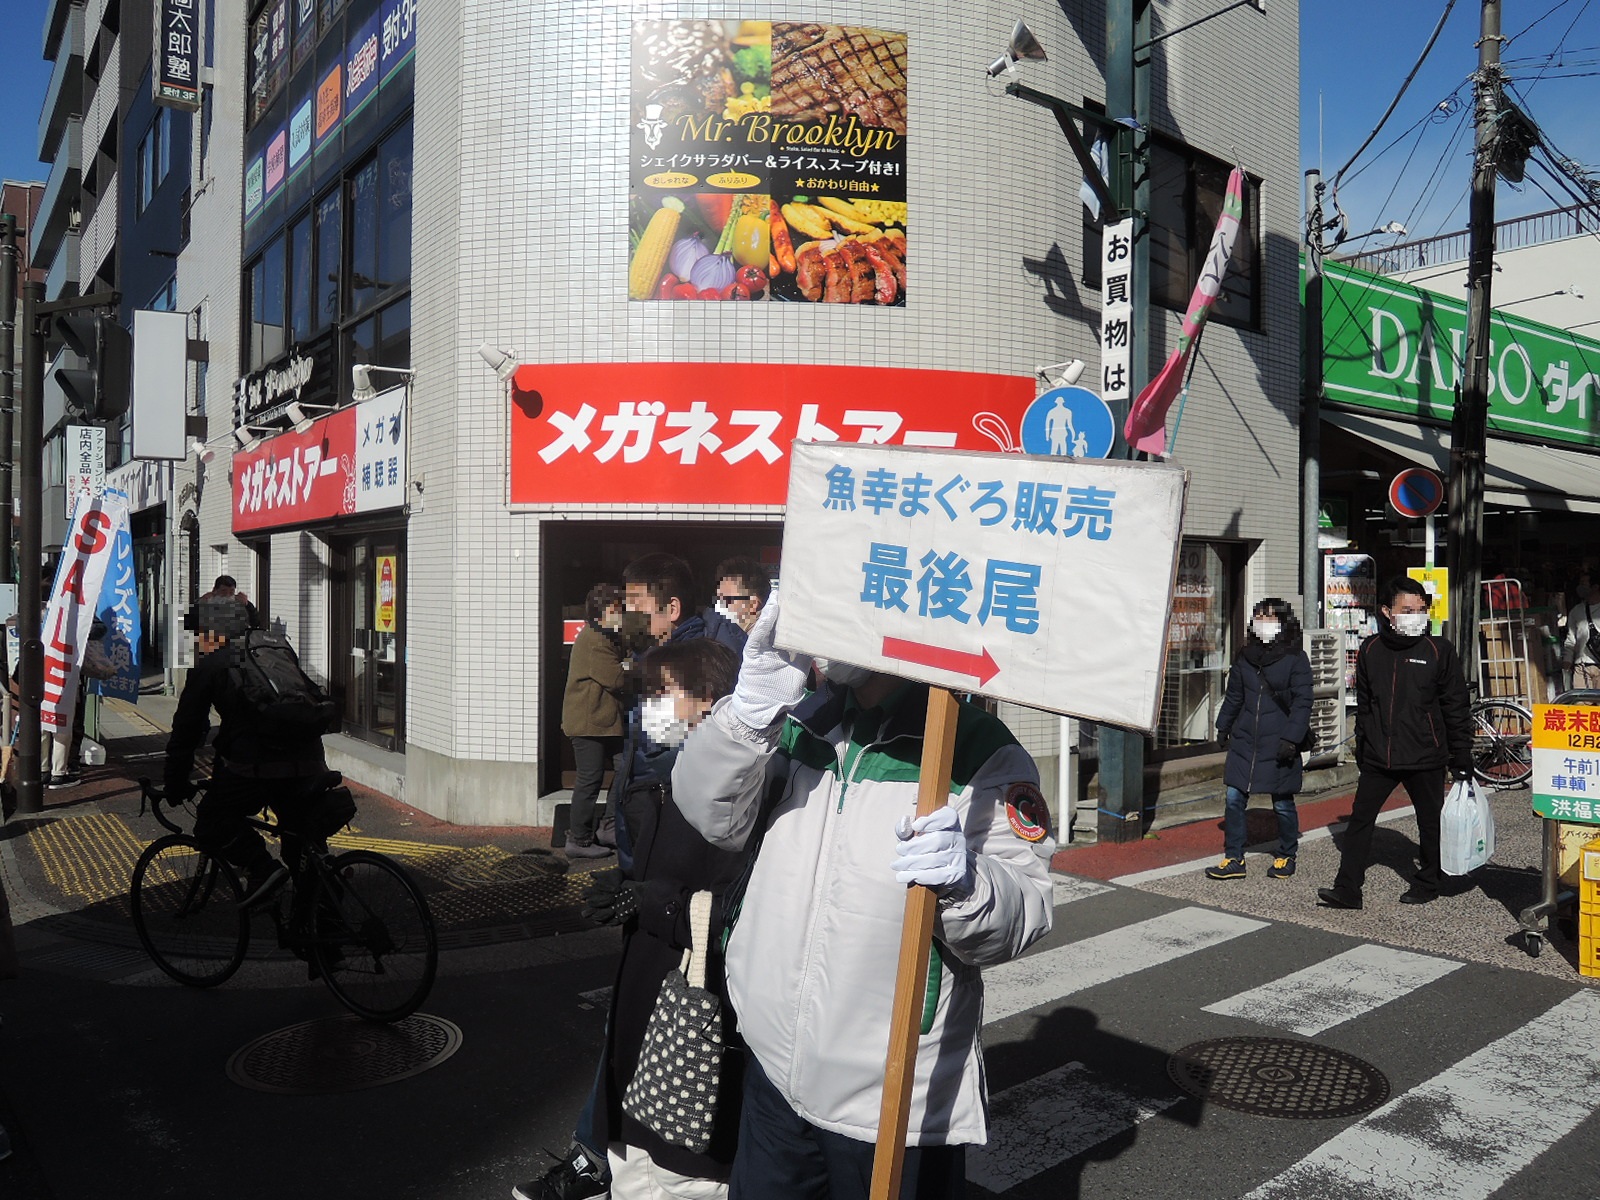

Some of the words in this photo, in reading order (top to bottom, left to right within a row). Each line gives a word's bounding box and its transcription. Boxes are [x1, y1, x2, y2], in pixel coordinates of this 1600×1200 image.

[382, 4, 401, 61] 受付
[163, 86, 180, 98] 受付
[182, 91, 196, 100] 3F
[676, 114, 732, 142] Mr.
[741, 114, 900, 157] Brooklyn
[806, 178, 870, 192] おかわり自由
[1104, 234, 1129, 391] お買物は
[1543, 360, 1600, 419] ダイ
[362, 413, 402, 448] メガネ
[538, 400, 959, 464] メガネストアー
[239, 445, 338, 515] メガネストアー
[362, 456, 398, 491] 補聴器
[821, 463, 1117, 541] 魚幸まぐろ販売
[43, 509, 111, 705] SALE
[109, 535, 135, 673] レンズ交換
[860, 542, 1043, 636] 最後尾
